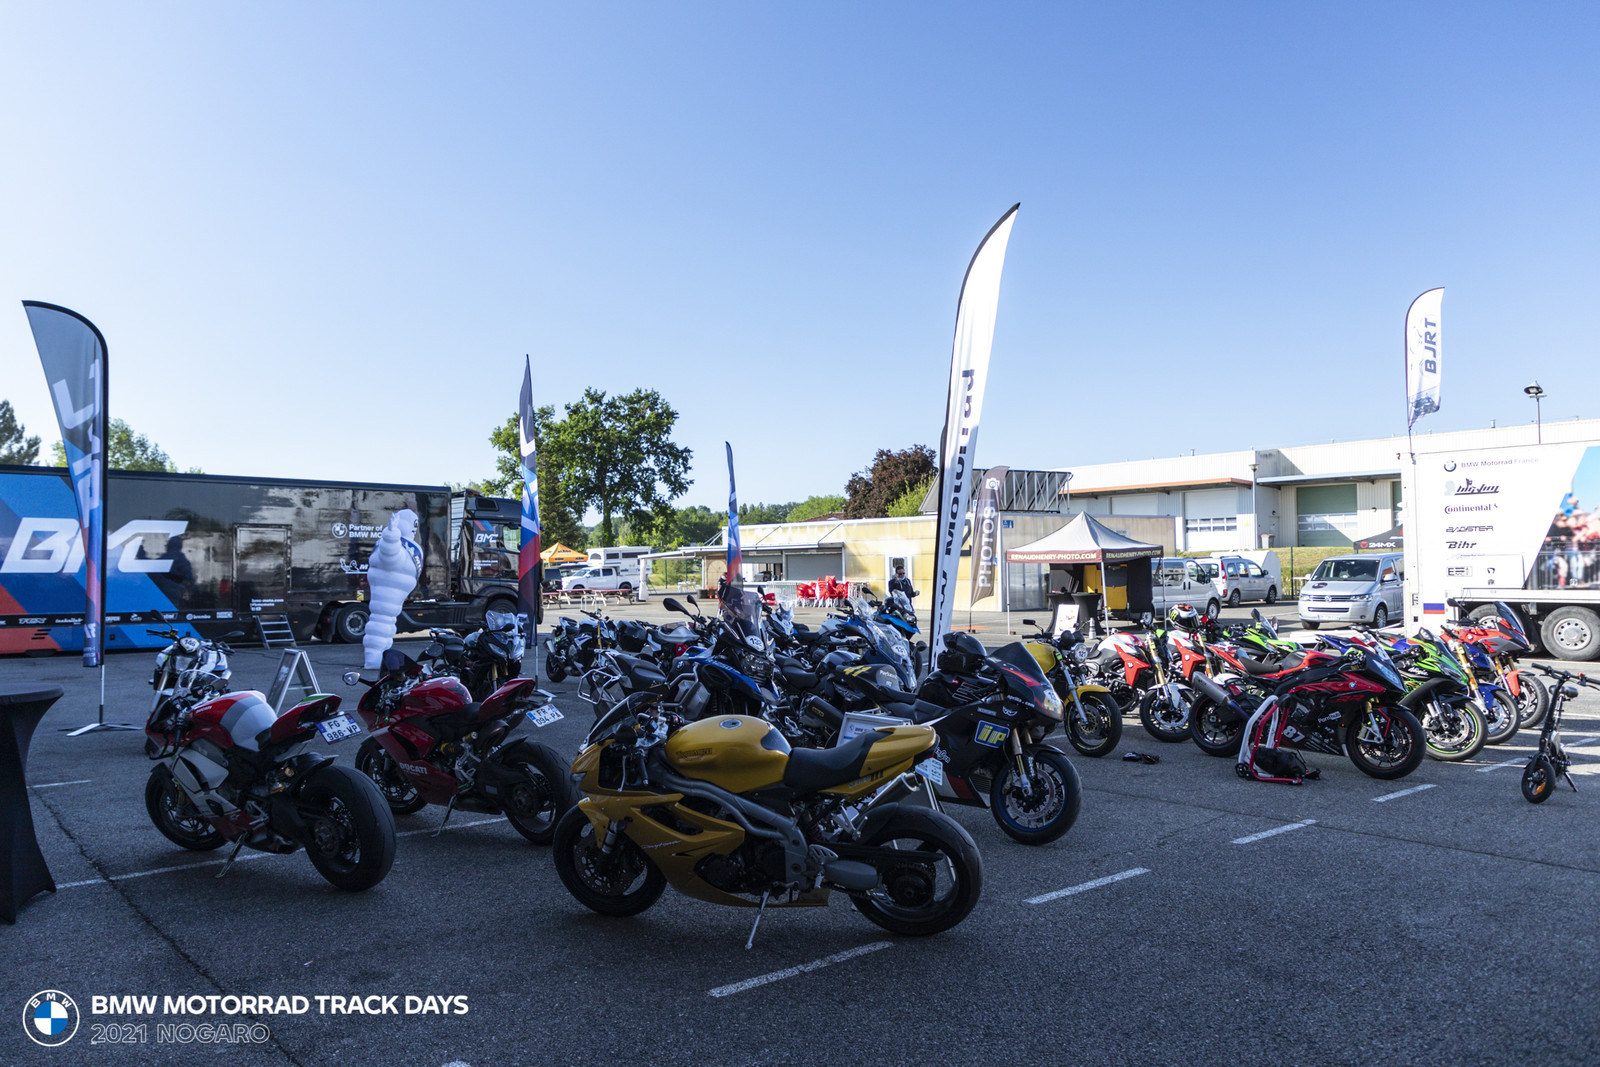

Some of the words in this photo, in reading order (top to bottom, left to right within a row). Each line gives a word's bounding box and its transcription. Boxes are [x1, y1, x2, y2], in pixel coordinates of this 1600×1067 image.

[1424, 317, 1437, 374] BJRT
[1480, 459, 1513, 467] Motorrad
[1444, 503, 1491, 514] Continental
[348, 523, 375, 532] Partner
[375, 523, 383, 532] of
[474, 533, 499, 543] BMC
[978, 506, 996, 588] PHOTOS
[1446, 540, 1477, 549] Bihr
[1010, 552, 1097, 561] RENAUDHENRY-PHOTO.COM
[535, 712, 562, 725] 094-PA
[326, 724, 358, 741] 986-VP
[1282, 725, 1306, 743] 87
[399, 762, 428, 775] DUCATI
